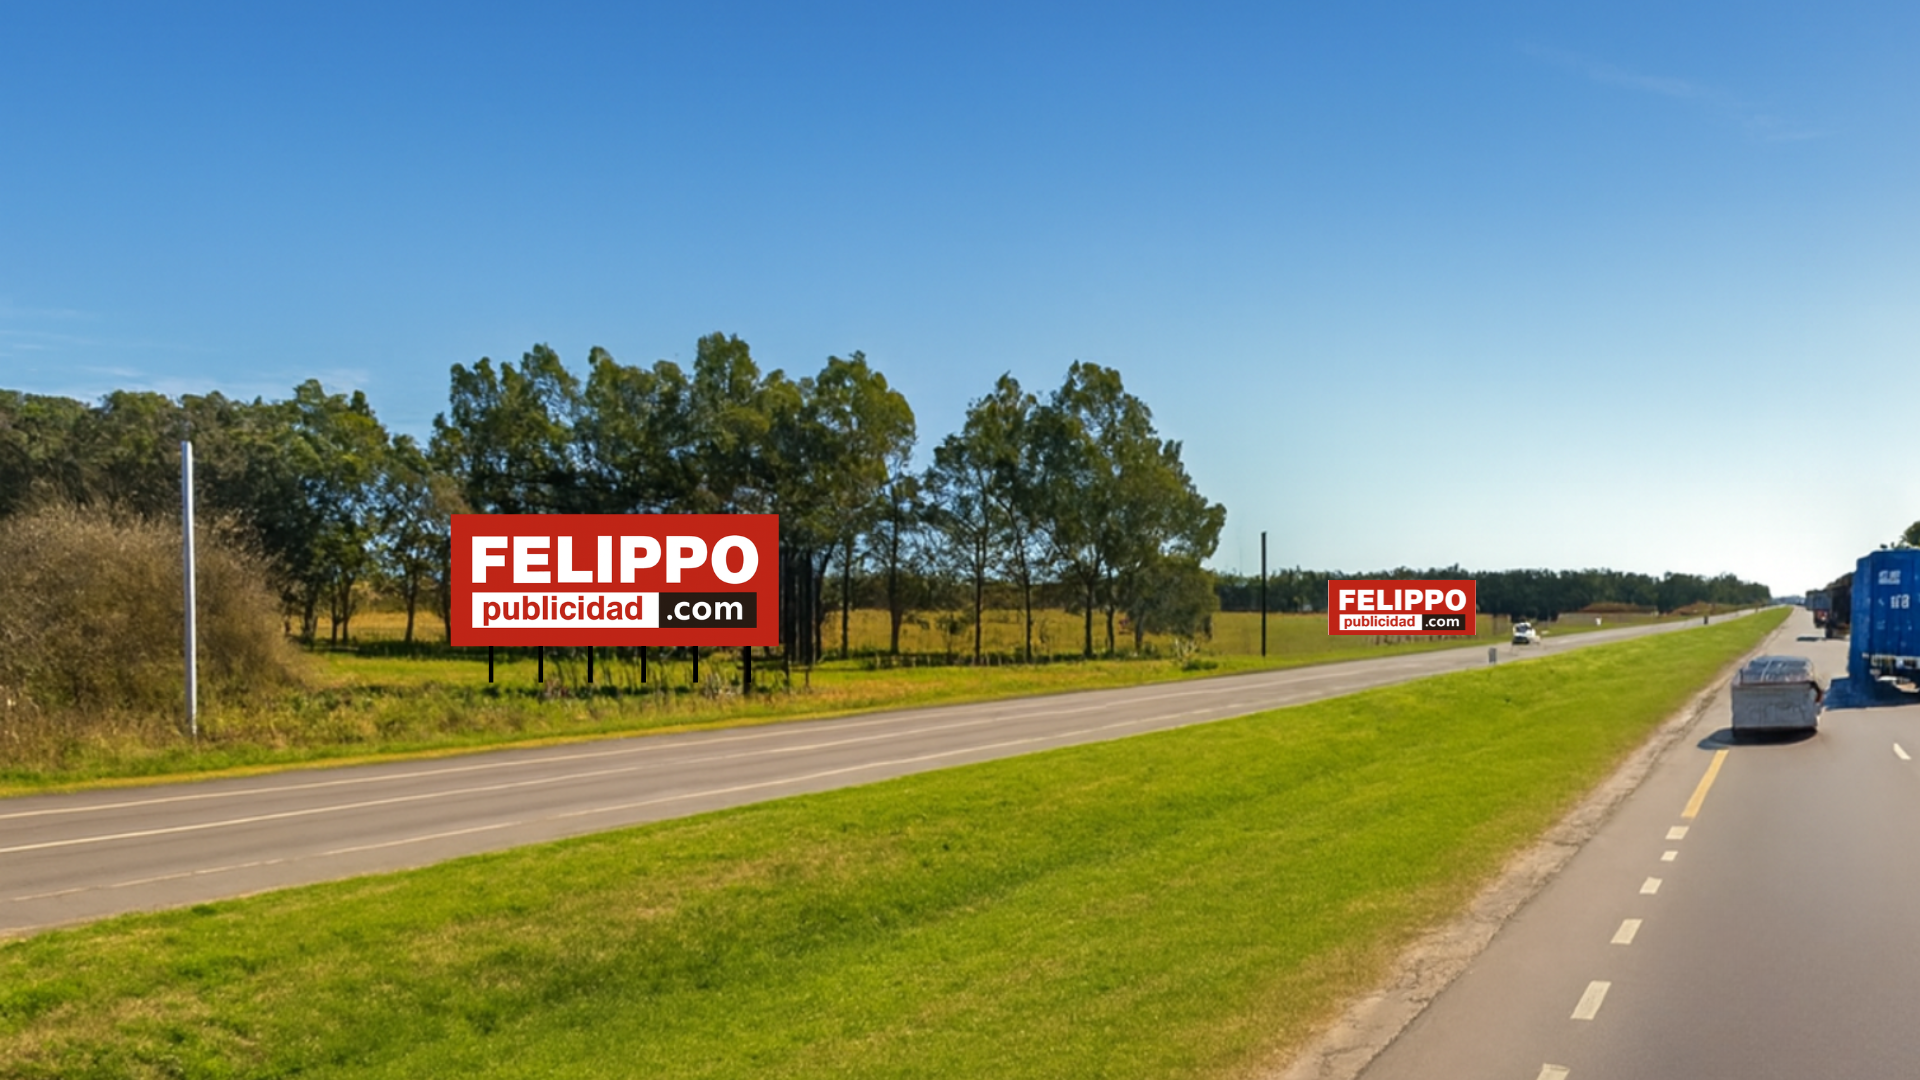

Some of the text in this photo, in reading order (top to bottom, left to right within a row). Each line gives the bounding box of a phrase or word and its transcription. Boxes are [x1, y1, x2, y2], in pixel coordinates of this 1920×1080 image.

[471, 534, 759, 585] FELIPPO
[482, 595, 743, 626] publicidad .com
[1339, 589, 1467, 611] FELIPPO
[1344, 616, 1460, 629] publicidad .com
